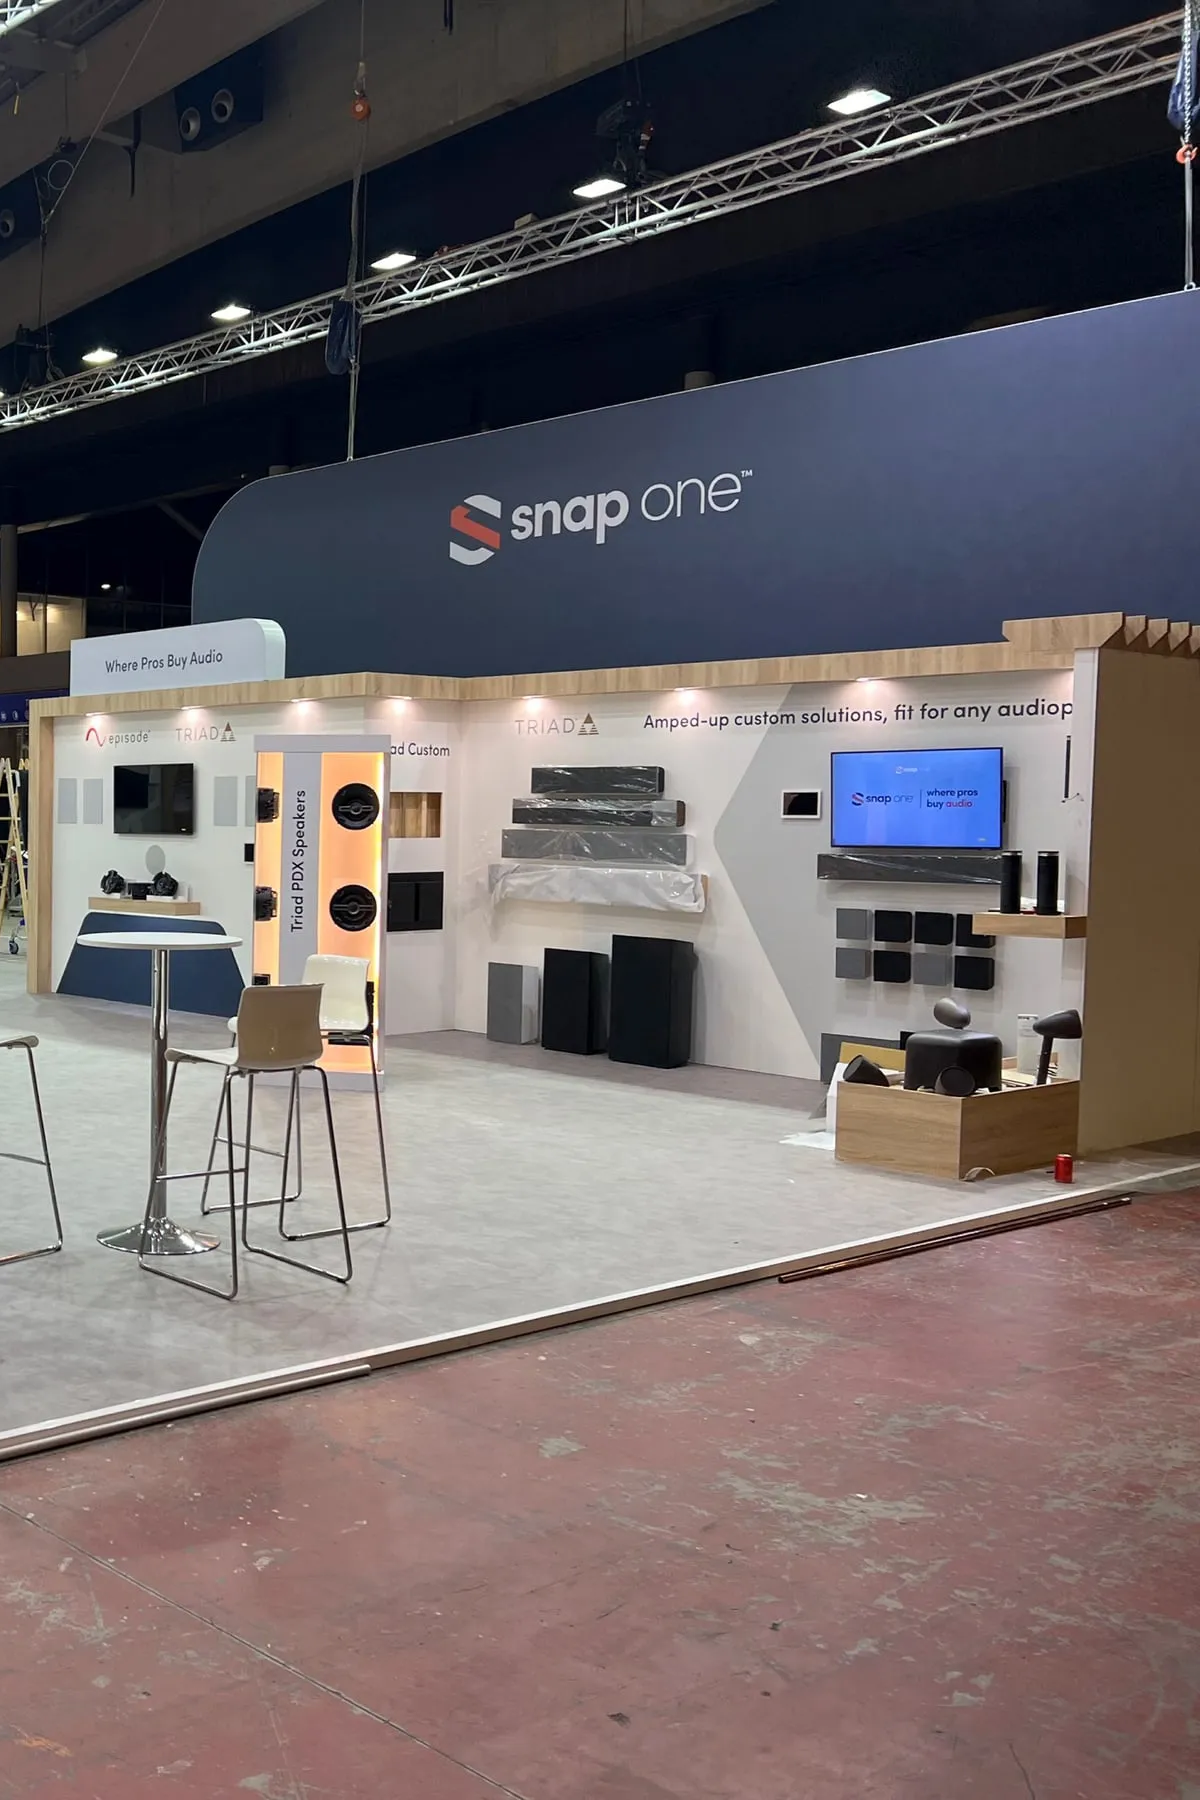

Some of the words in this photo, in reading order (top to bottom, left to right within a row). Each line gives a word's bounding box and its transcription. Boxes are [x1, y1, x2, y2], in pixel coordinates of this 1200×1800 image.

[510, 490, 629, 544] snap
[105, 660, 139, 673] Where
[141, 656, 165, 670] Pros
[167, 654, 188, 670] Buy
[189, 649, 224, 665] Audio
[514, 717, 576, 735] TRIAD
[644, 713, 729, 731] Amped-up
[734, 710, 796, 726] custom
[801, 706, 888, 724] solutions,
[894, 704, 914, 721] fit
[919, 703, 949, 720] for
[953, 704, 992, 722] any
[108, 731, 149, 747] episode
[408, 742, 450, 756] Custom
[866, 793, 892, 805] snap
[893, 794, 914, 803] one
[926, 787, 956, 797] where
[957, 789, 978, 798] pros
[926, 800, 944, 809] buy
[945, 799, 973, 808] audio
[292, 790, 308, 858] Speakers
[292, 860, 305, 892] PDX
[291, 895, 304, 933] Triad
